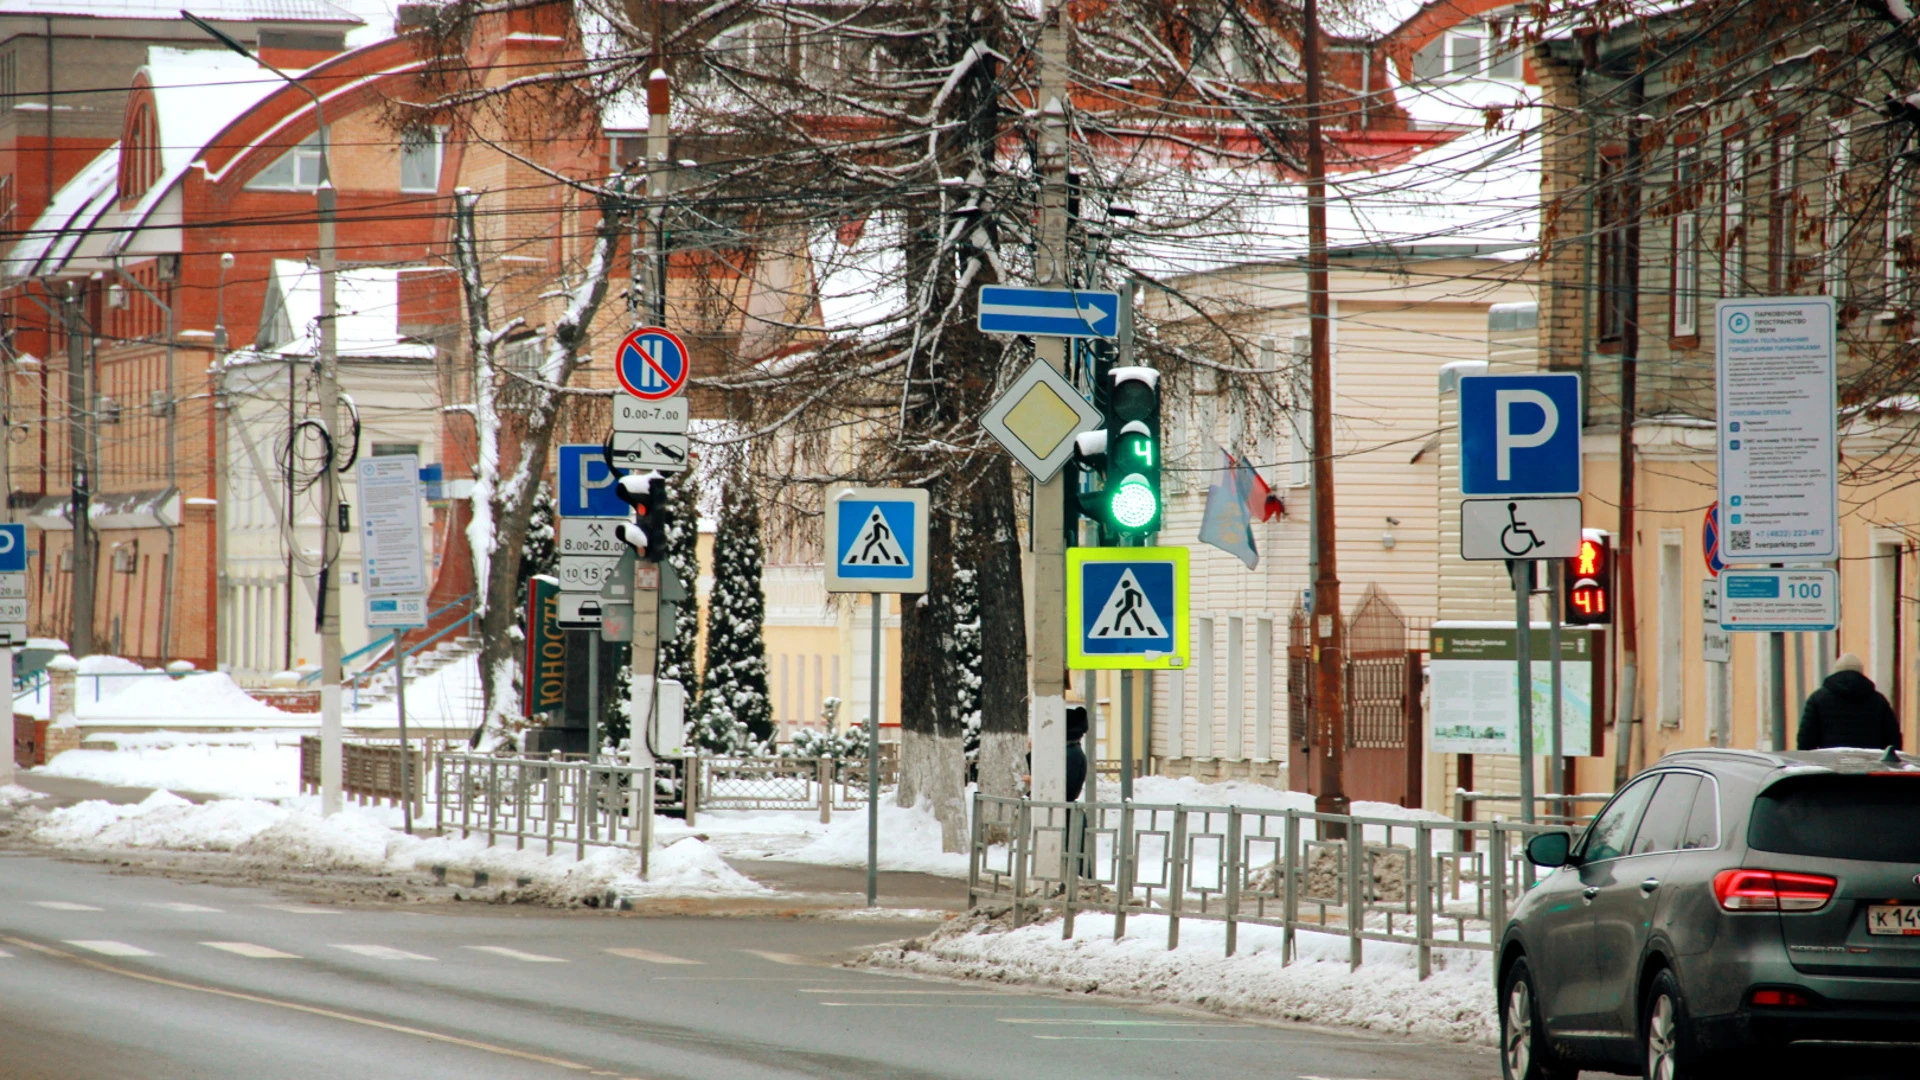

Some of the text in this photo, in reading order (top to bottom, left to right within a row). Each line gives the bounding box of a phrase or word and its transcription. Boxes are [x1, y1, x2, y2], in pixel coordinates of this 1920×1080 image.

[623, 407, 679, 420] 0.00-7.00
[1496, 389, 1559, 481] P
[1134, 440, 1152, 466] 4
[580, 453, 616, 509] P
[1755, 541, 1816, 549] tverparking.com
[583, 568, 599, 580] 15
[1788, 583, 1821, 598] 100
[1574, 590, 1604, 613] 41
